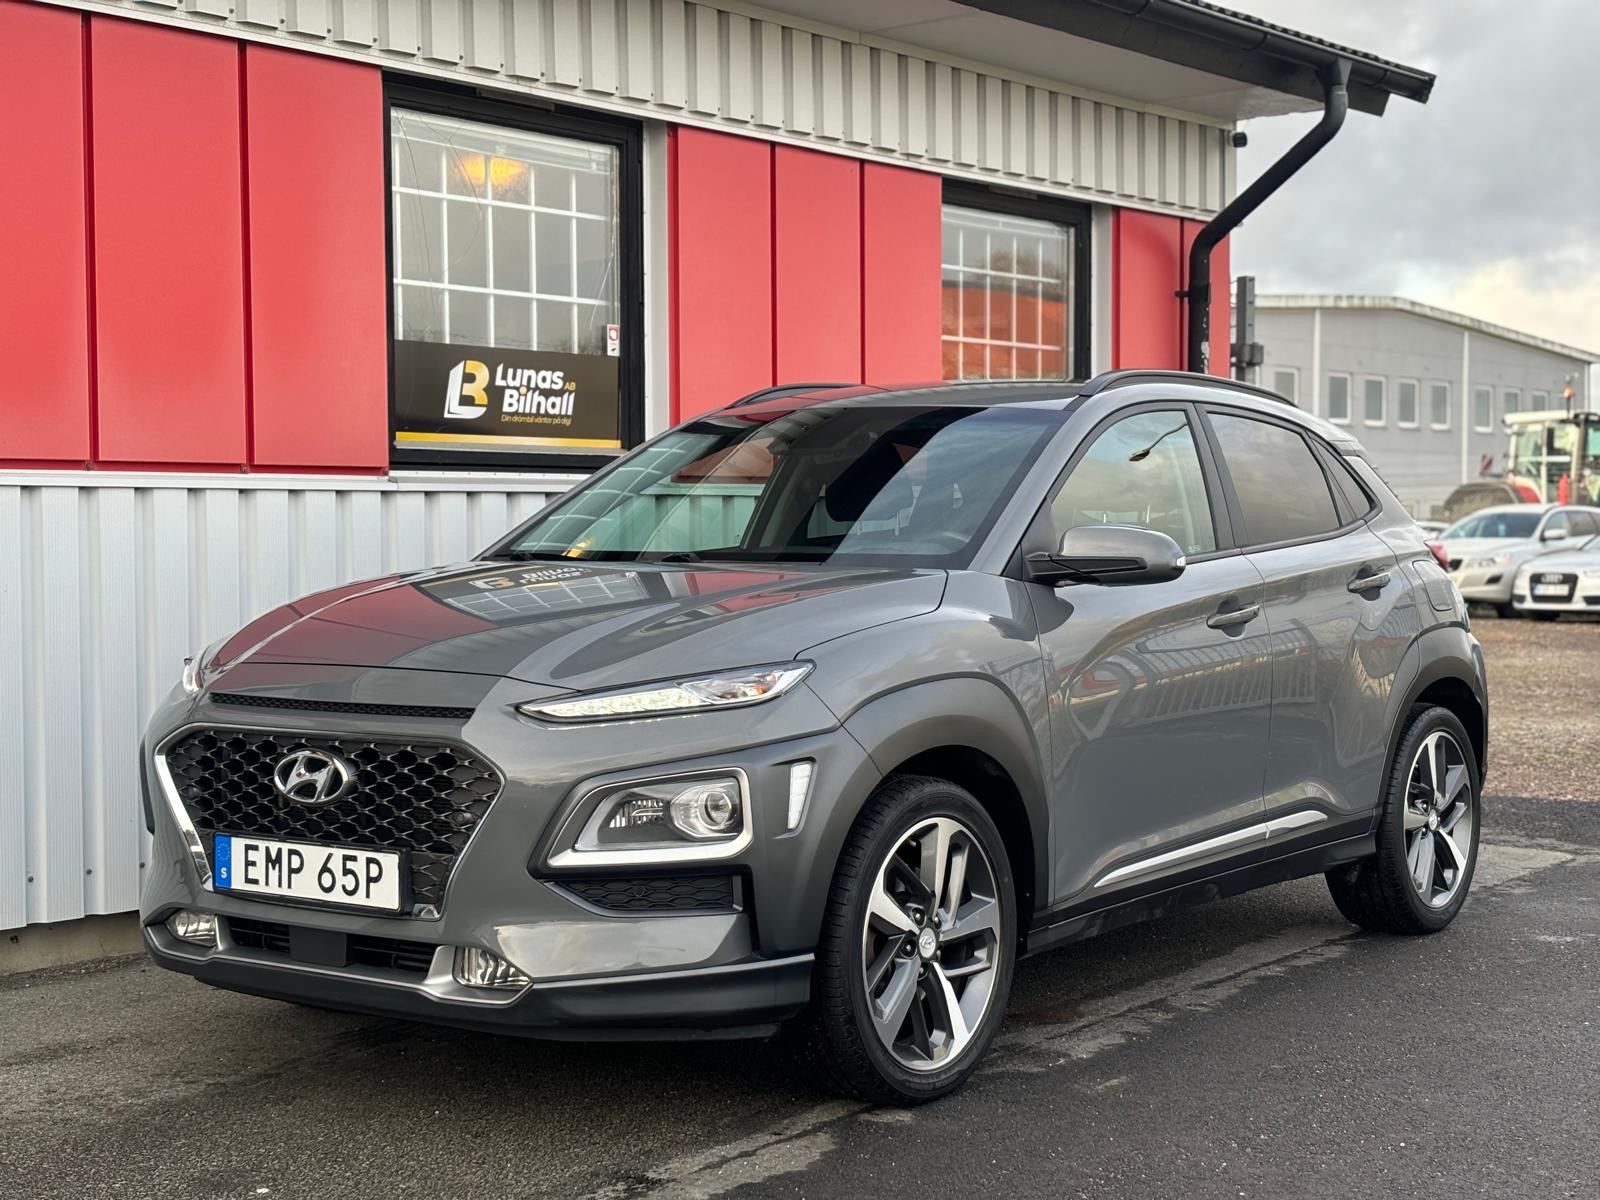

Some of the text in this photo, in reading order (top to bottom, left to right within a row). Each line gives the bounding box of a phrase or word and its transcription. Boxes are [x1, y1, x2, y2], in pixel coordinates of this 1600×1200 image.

[495, 363, 576, 391] Lunas AB
[502, 386, 575, 415] Bilhall
[220, 867, 227, 878] S
[244, 843, 383, 899] EMP 65P
